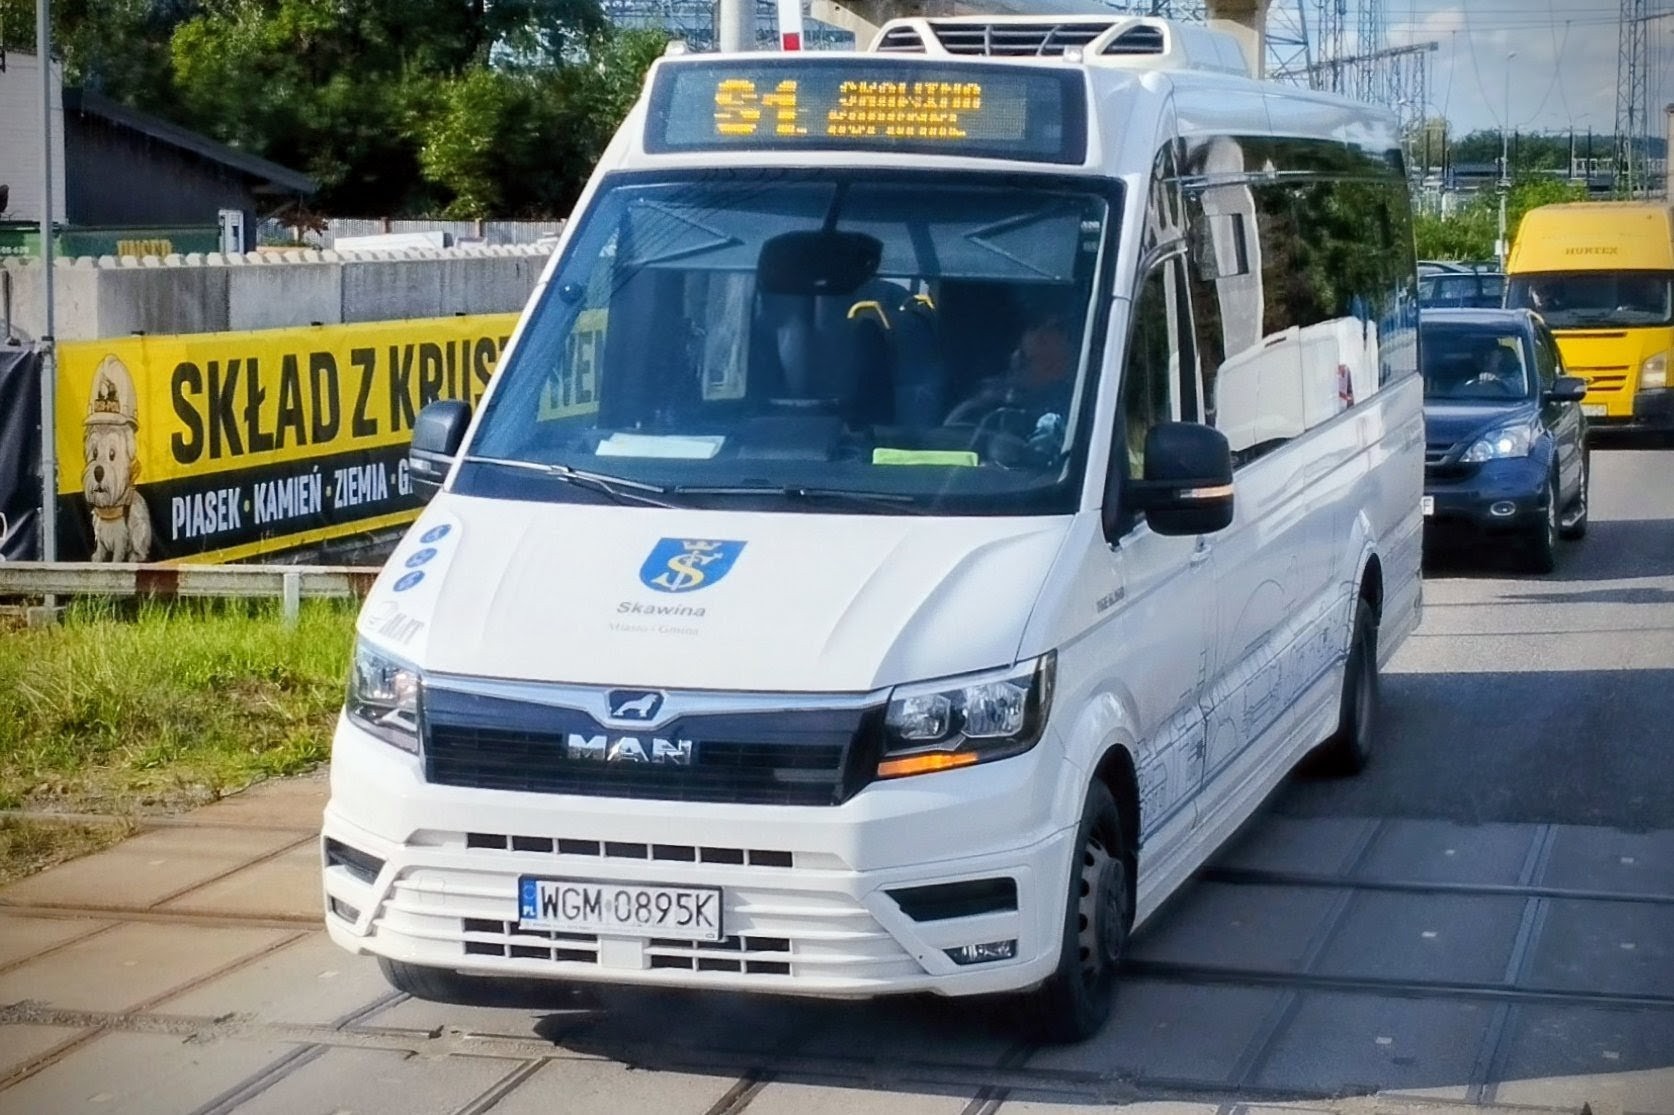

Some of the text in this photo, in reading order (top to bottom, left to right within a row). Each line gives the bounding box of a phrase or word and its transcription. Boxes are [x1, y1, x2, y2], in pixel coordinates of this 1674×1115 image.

[171, 352, 340, 464] SKŁAD
[351, 348, 378, 438] Z
[172, 487, 241, 541] PIASEK
[254, 465, 322, 525] KAMIEŃ
[334, 462, 388, 509] ZIEMIA
[617, 601, 706, 617] Skawina
[568, 733, 692, 765] MAN
[523, 905, 537, 918] PL
[541, 886, 714, 928] WGM 0895K
